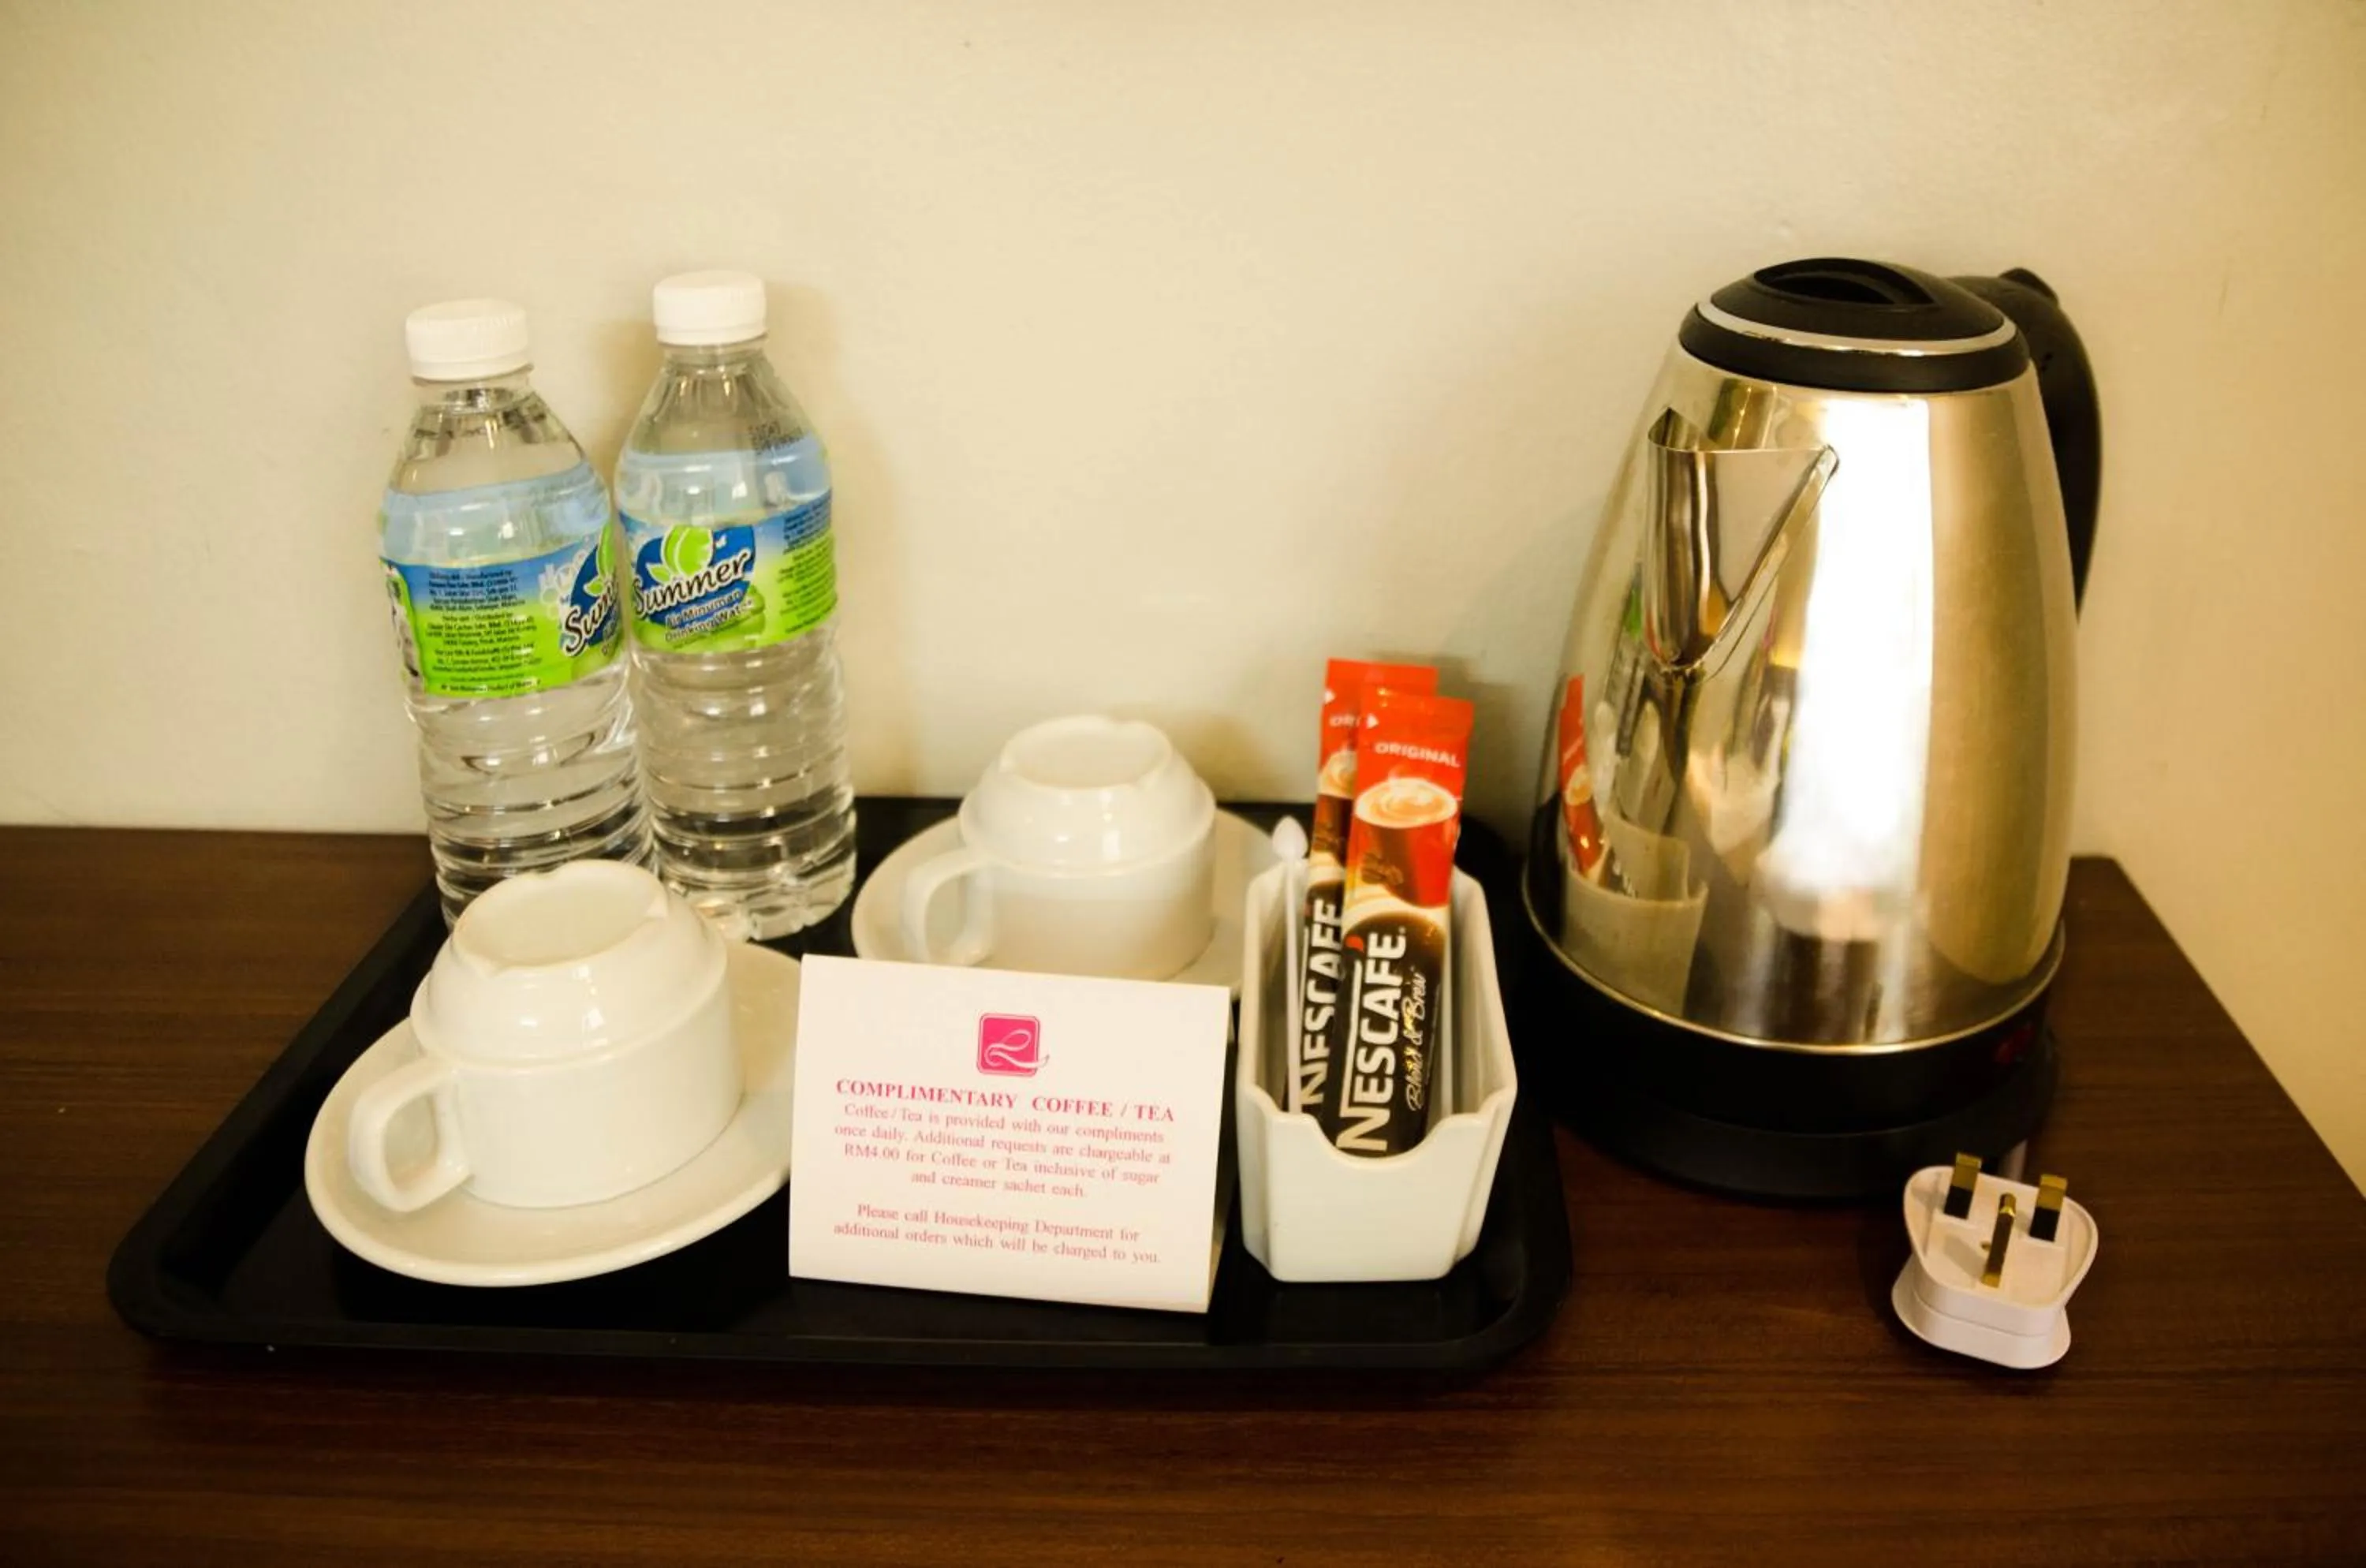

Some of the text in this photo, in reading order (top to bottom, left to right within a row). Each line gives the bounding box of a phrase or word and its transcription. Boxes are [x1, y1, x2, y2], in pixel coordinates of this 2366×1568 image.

[632, 548, 752, 618] Summer
[1375, 742, 1461, 768] ORIGINAL
[836, 1079, 1017, 1108] COMPLIMENTARY
[1032, 1096, 1113, 1118] COFFEE
[1134, 1103, 1174, 1122] TEA
[834, 1126, 866, 1137] once
[914, 1130, 985, 1148] Additional
[991, 1140, 1047, 1154] requests
[1053, 1144, 1073, 1156] are
[1079, 1144, 1153, 1164] chargeable
[1159, 1152, 1171, 1164] at
[929, 1112, 939, 1124] is
[946, 1113, 1005, 1129] provided
[1011, 1118, 1041, 1133] with
[1047, 1124, 1069, 1137] our
[1075, 1126, 1164, 1144] compliments
[845, 1143, 1160, 1185] RM4.00 for Coffee or Tea inclusive of sugar
[911, 1170, 936, 1184] and
[942, 1175, 997, 1189] creamer
[1002, 1178, 1046, 1194] sachet
[857, 1203, 1140, 1242] Please call Housekeeping Department for
[834, 1222, 1160, 1264] additional orders which will be charged to you.
